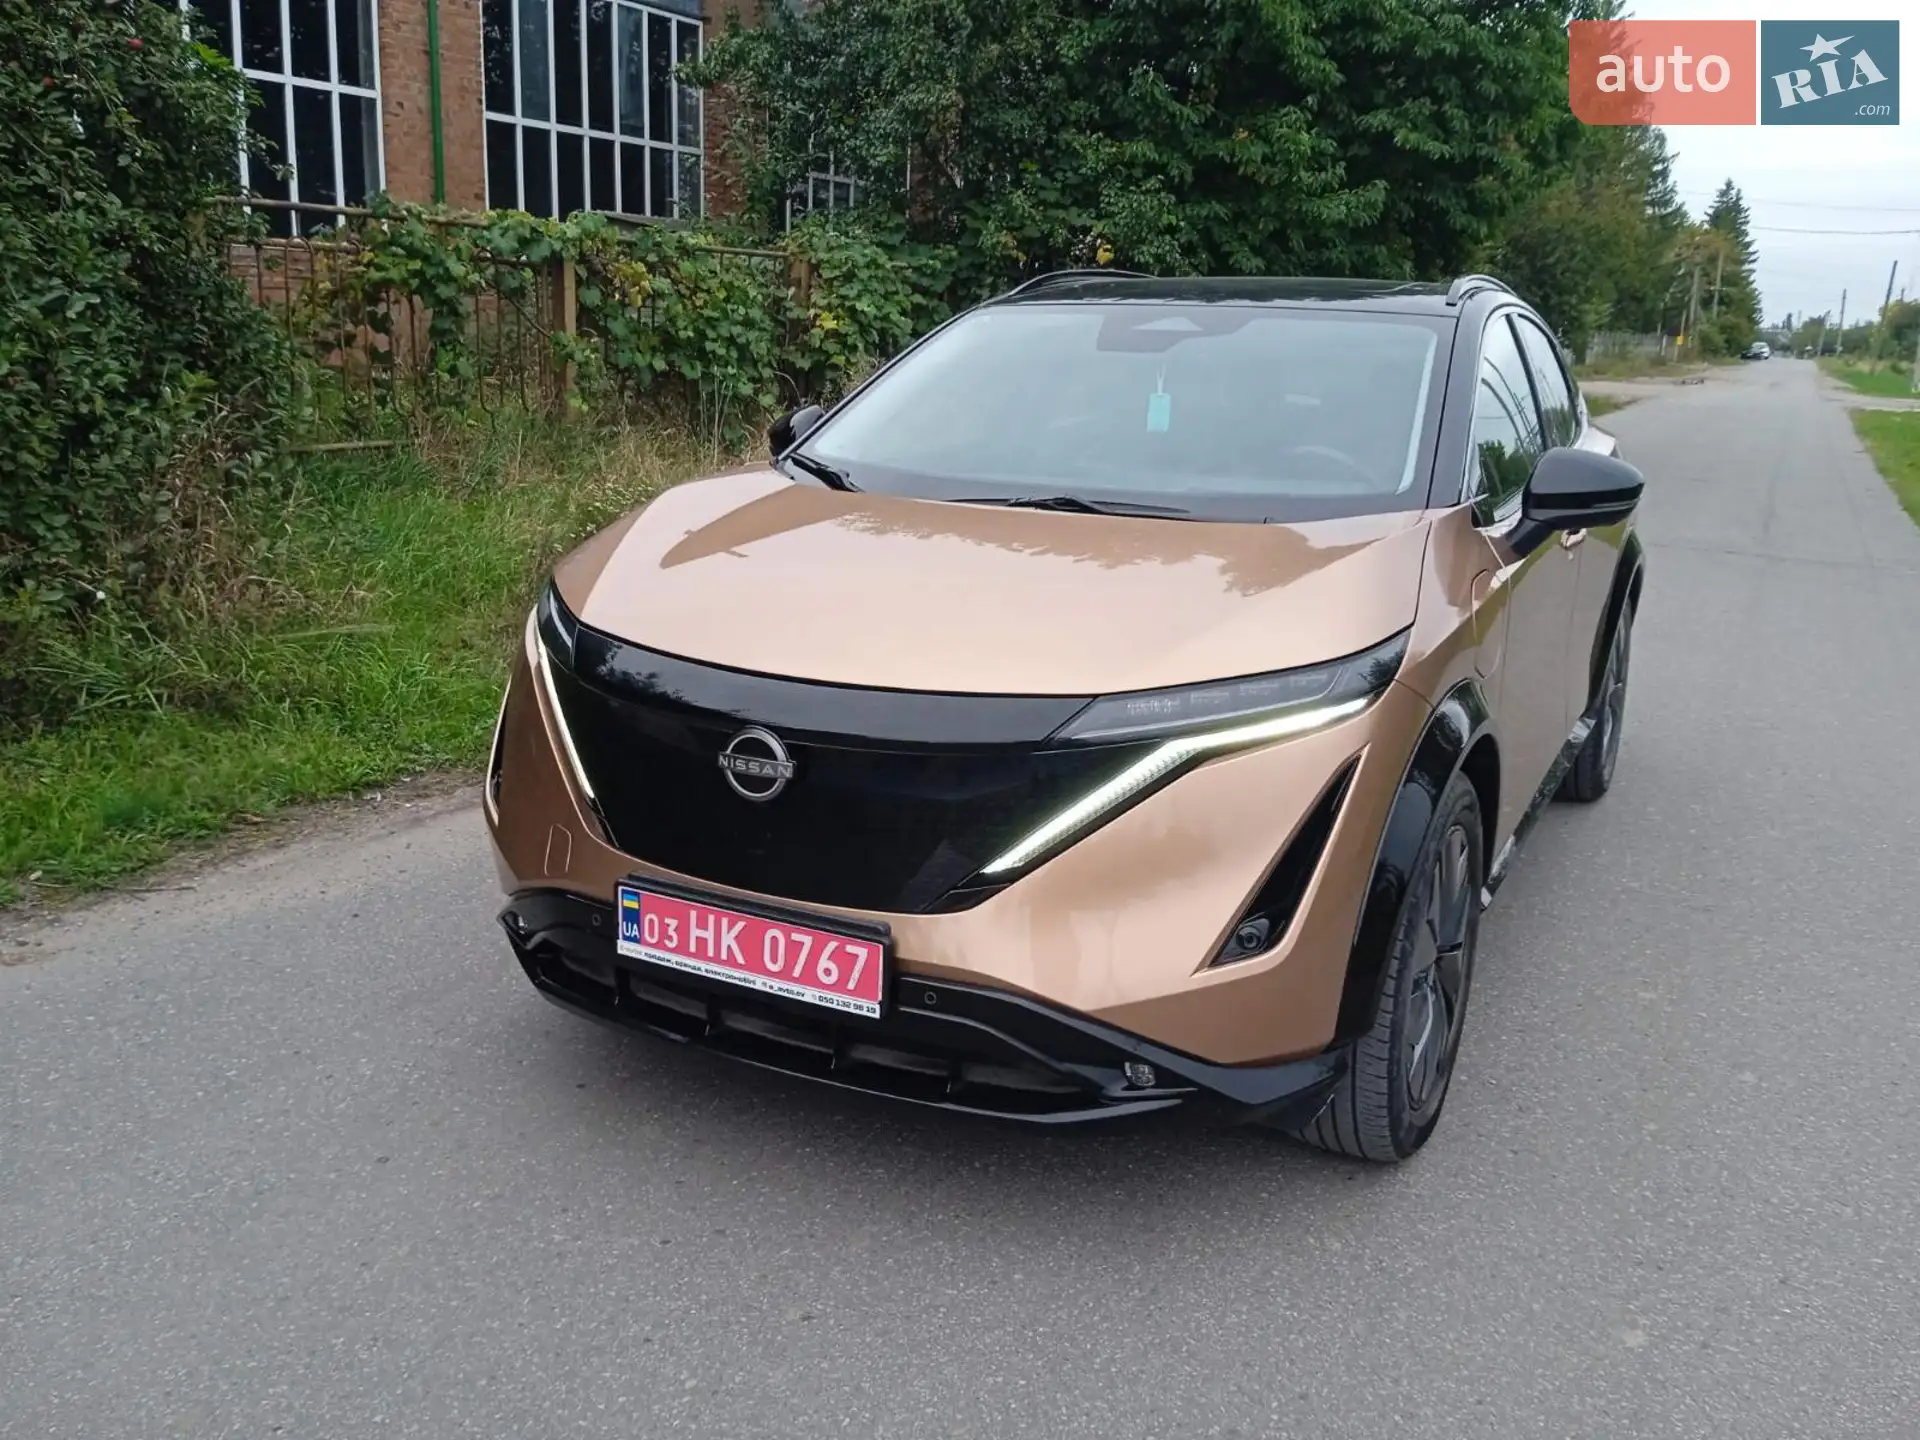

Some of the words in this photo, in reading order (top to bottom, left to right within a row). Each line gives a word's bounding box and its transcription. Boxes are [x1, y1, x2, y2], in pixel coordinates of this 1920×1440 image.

[719, 754, 793, 778] NISSAN
[622, 921, 640, 939] UA
[644, 913, 679, 949] 03
[689, 910, 747, 965] HK
[763, 928, 869, 991] 0767
